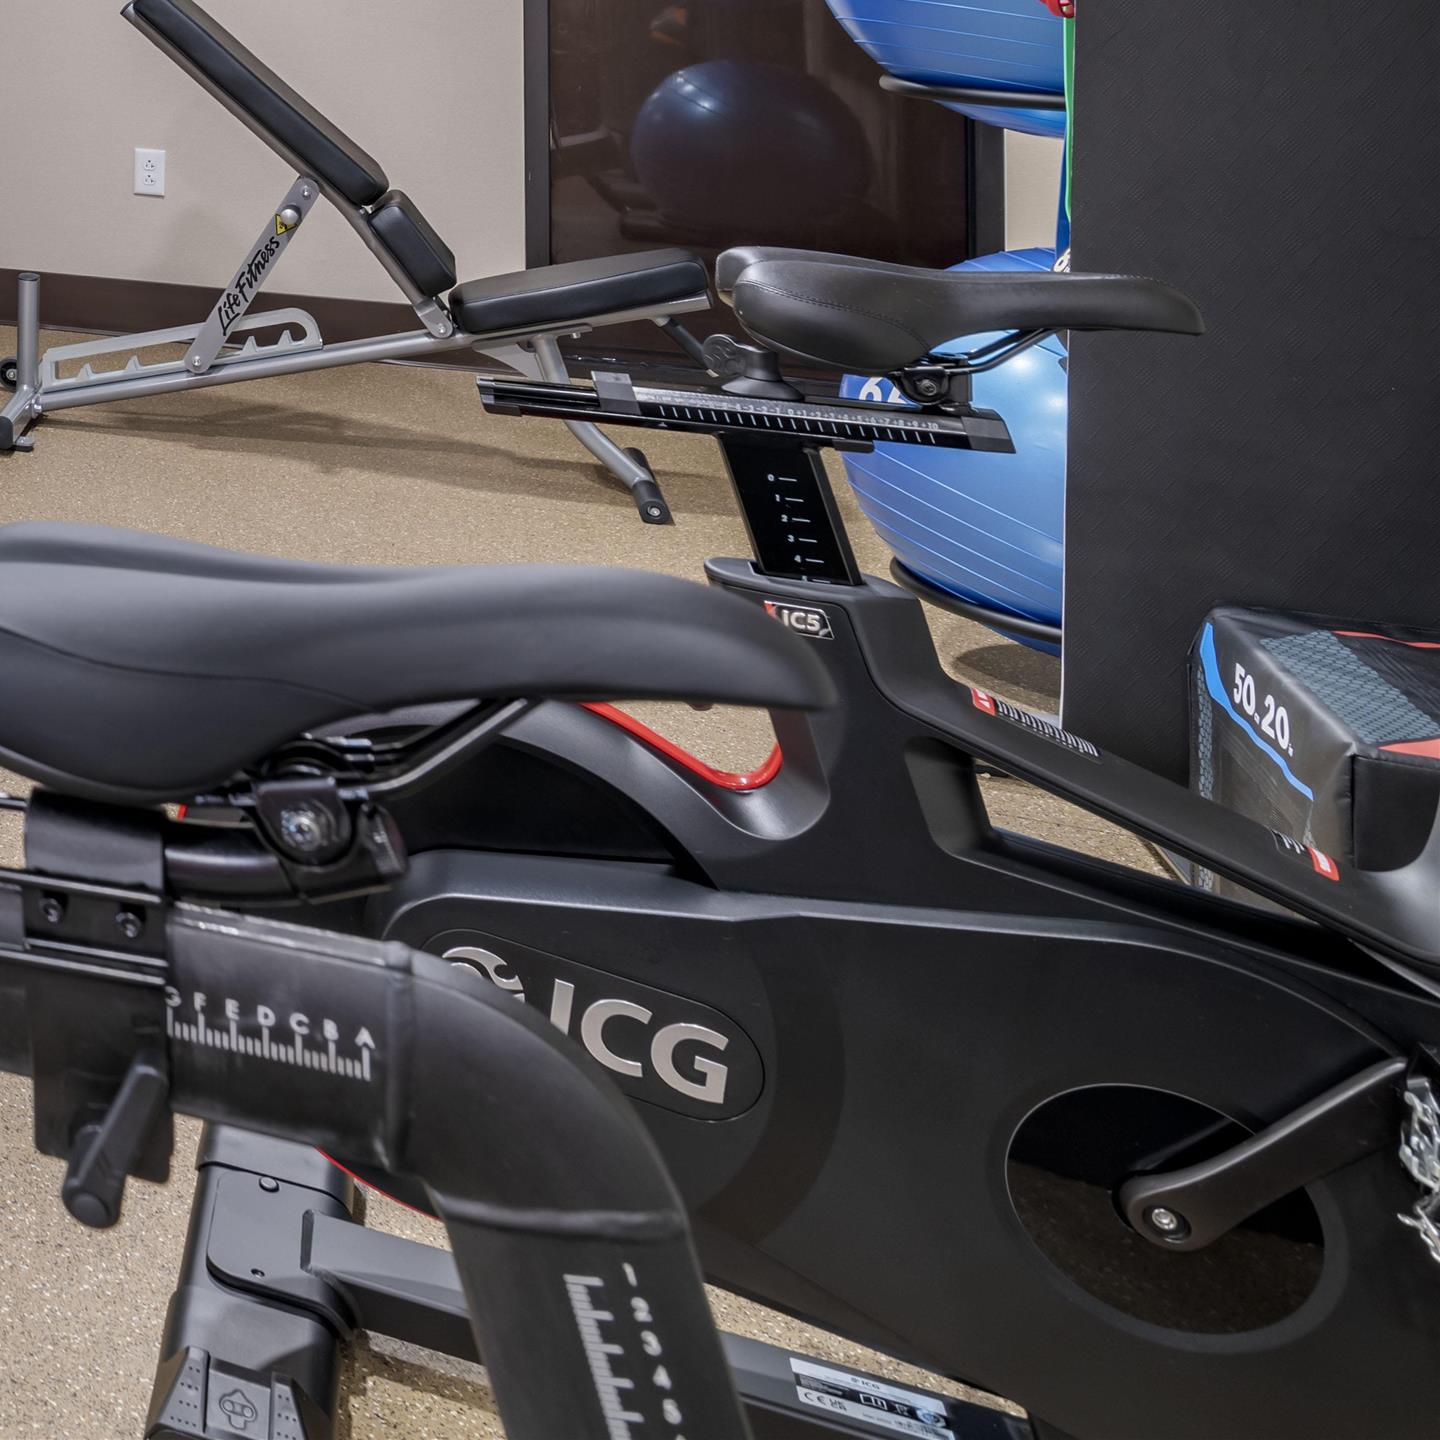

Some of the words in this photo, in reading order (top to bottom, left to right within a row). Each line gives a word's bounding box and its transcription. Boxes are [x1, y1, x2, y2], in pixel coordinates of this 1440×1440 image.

[767, 474, 775, 482] 0
[781, 514, 788, 523] 2
[787, 535, 795, 543] 3
[794, 555, 802, 563] 4
[194, 991, 206, 1011] F
[225, 998, 240, 1020] E
[257, 1005, 276, 1027] D
[290, 1012, 310, 1035] C
[355, 1026, 375, 1049] A
[550, 978, 729, 1104] ICG
[623, 1262, 637, 1287] 1
[630, 1296, 653, 1322] 2
[640, 1330, 662, 1356] 3
[652, 1364, 672, 1390] 4
